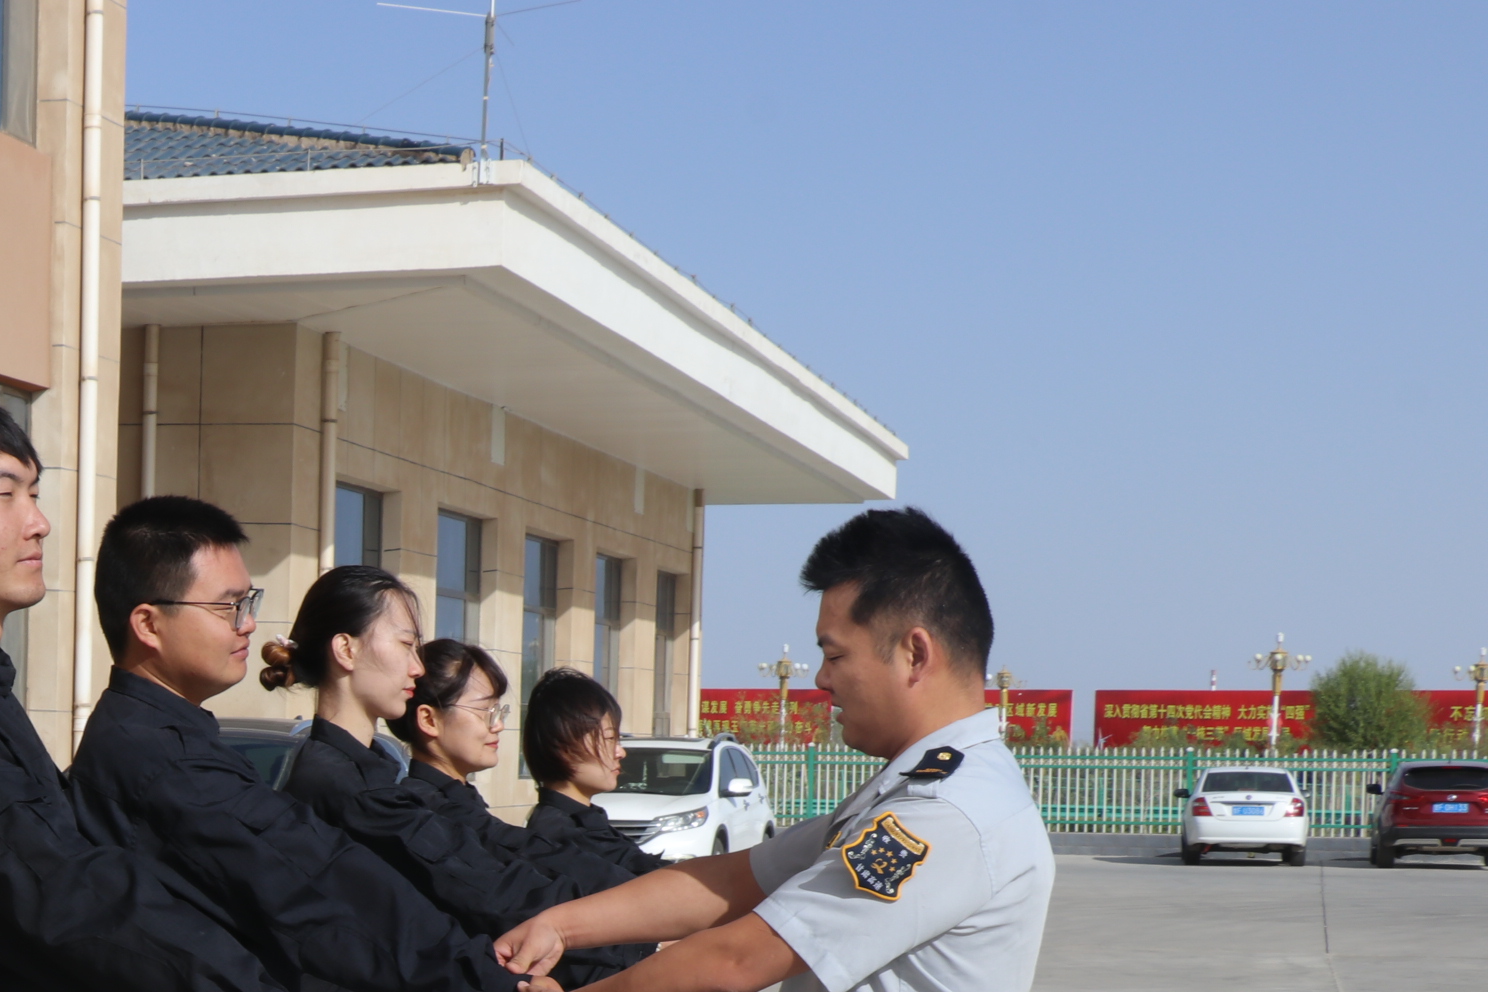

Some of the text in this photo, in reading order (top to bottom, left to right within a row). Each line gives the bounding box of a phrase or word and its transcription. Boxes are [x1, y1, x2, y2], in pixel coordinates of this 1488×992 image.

[734, 701, 799, 715] 奋勇争先走列
[1104, 704, 1232, 720] 深入贯彻省第十四次党代会精神
[854, 862, 884, 891] 甘肃高速
